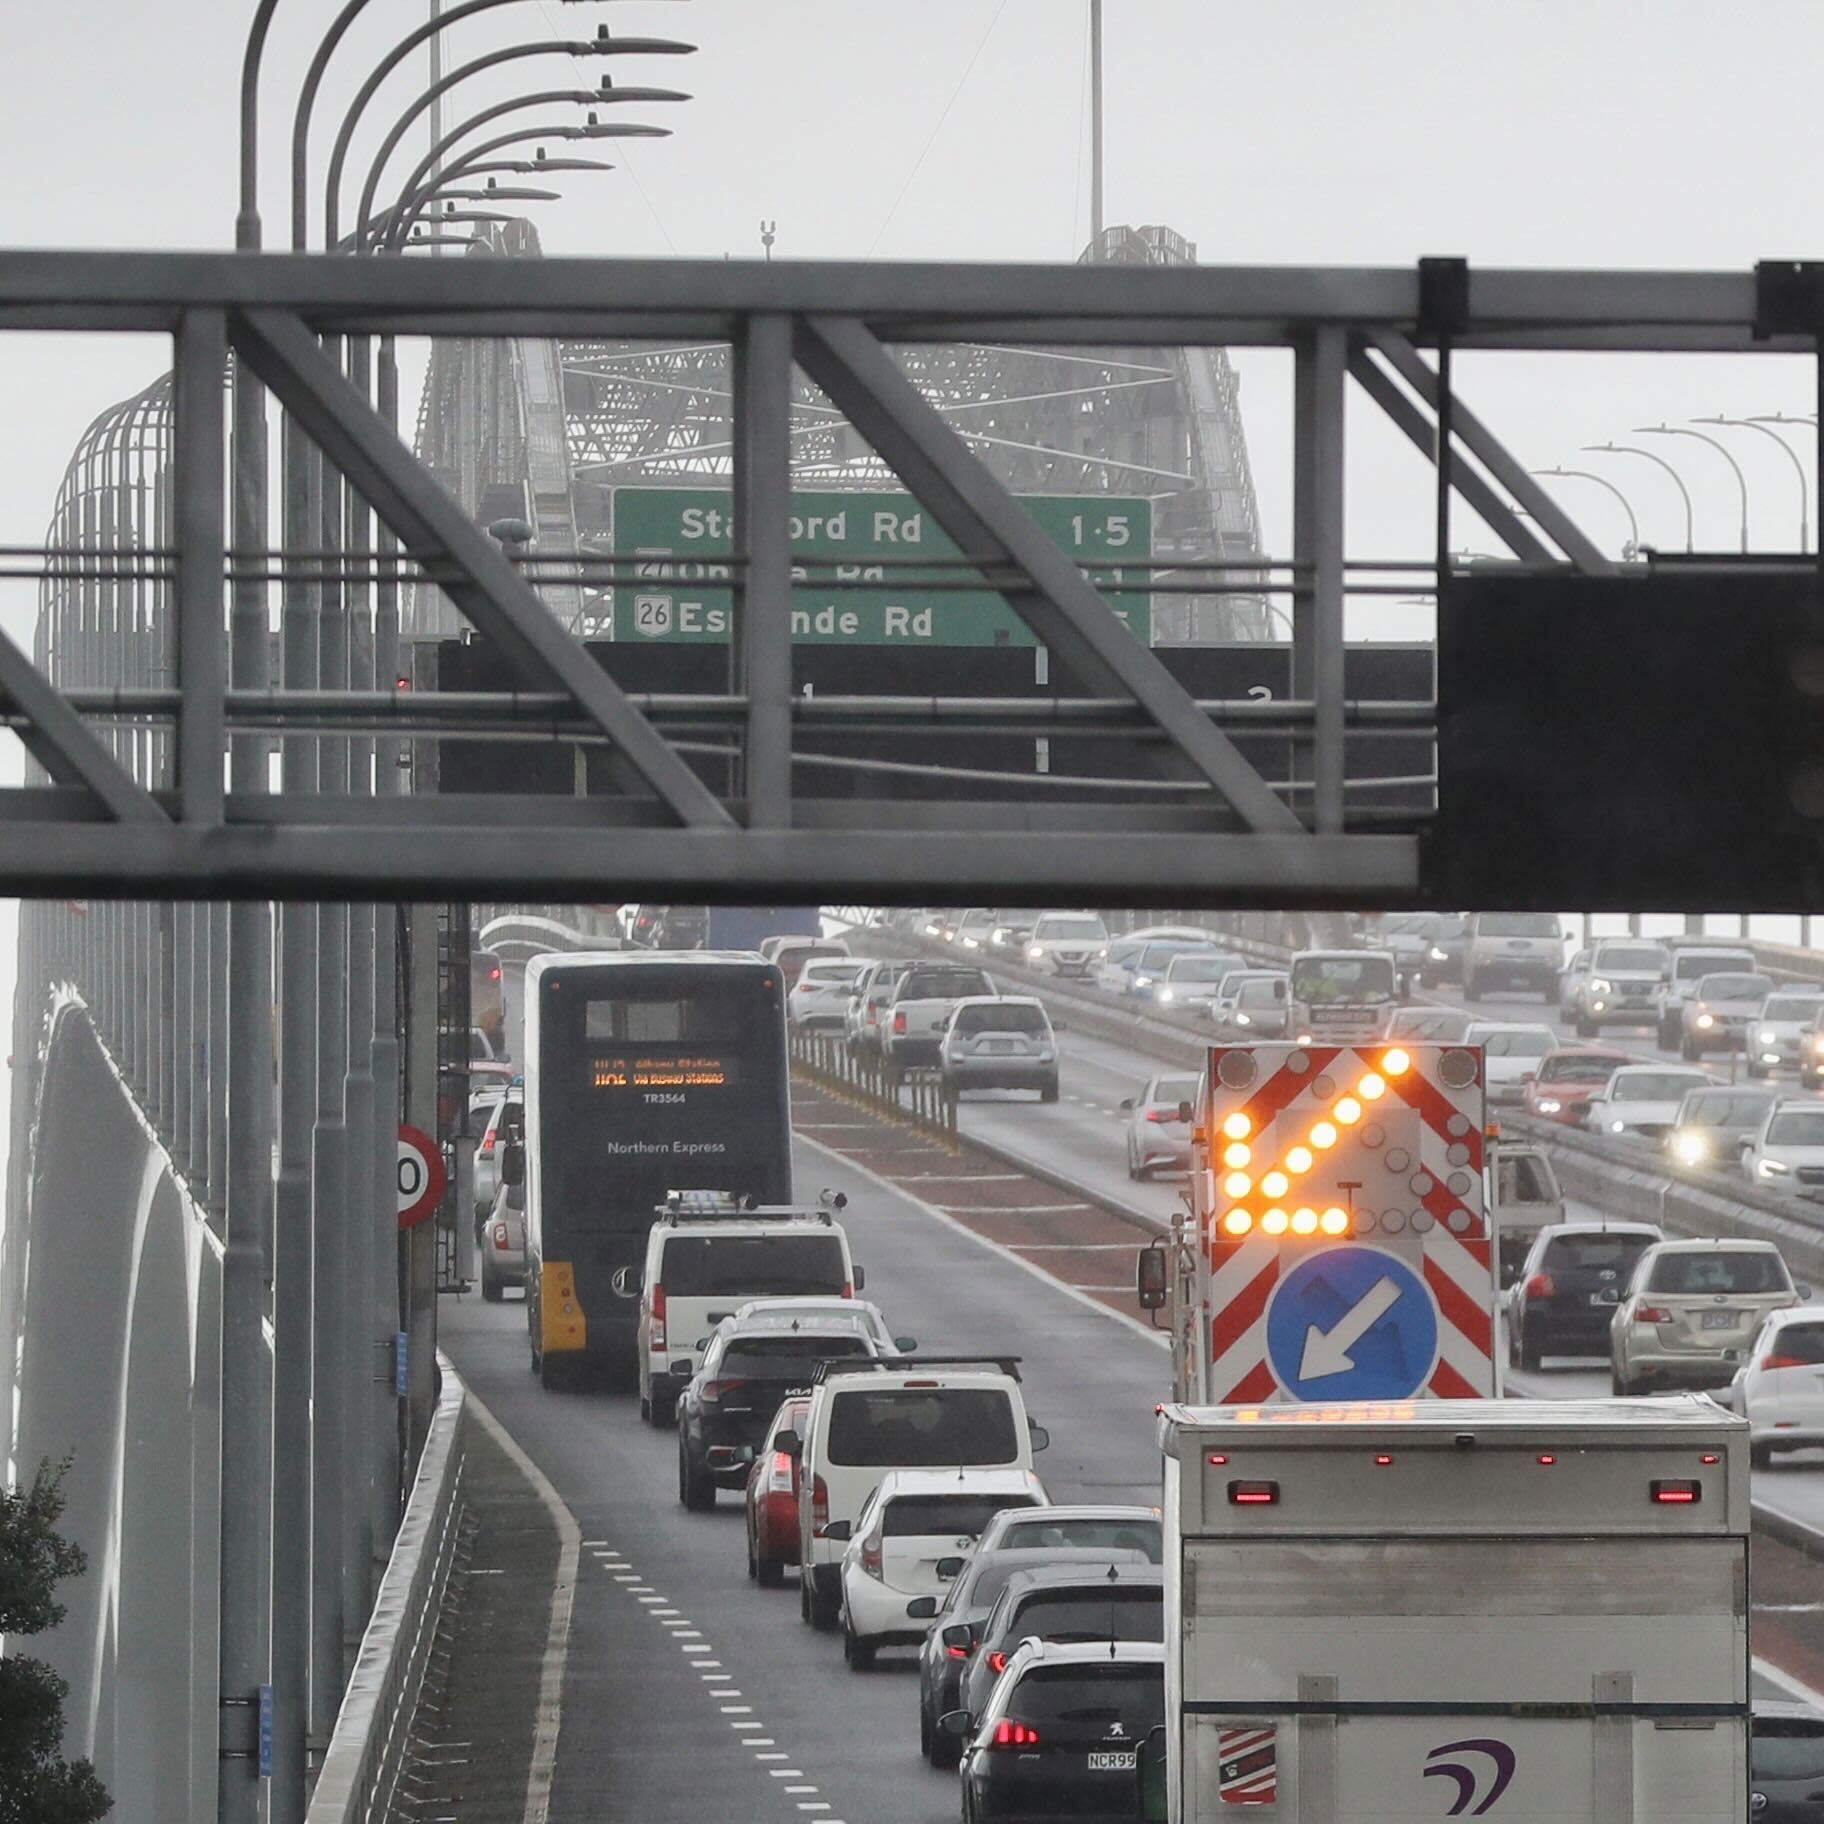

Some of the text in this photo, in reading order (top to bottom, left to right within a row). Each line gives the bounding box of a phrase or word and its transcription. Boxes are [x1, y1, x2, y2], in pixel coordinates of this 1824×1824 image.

[874, 512, 919, 541] Rd
[641, 603, 668, 626] 26
[680, 603, 932, 637] Esnde Rd
[644, 1093, 686, 1103] TR3564
[608, 1142, 726, 1155] Northern Express
[397, 1157, 421, 1195] 0
[1090, 1754, 1136, 1768] NCR99
